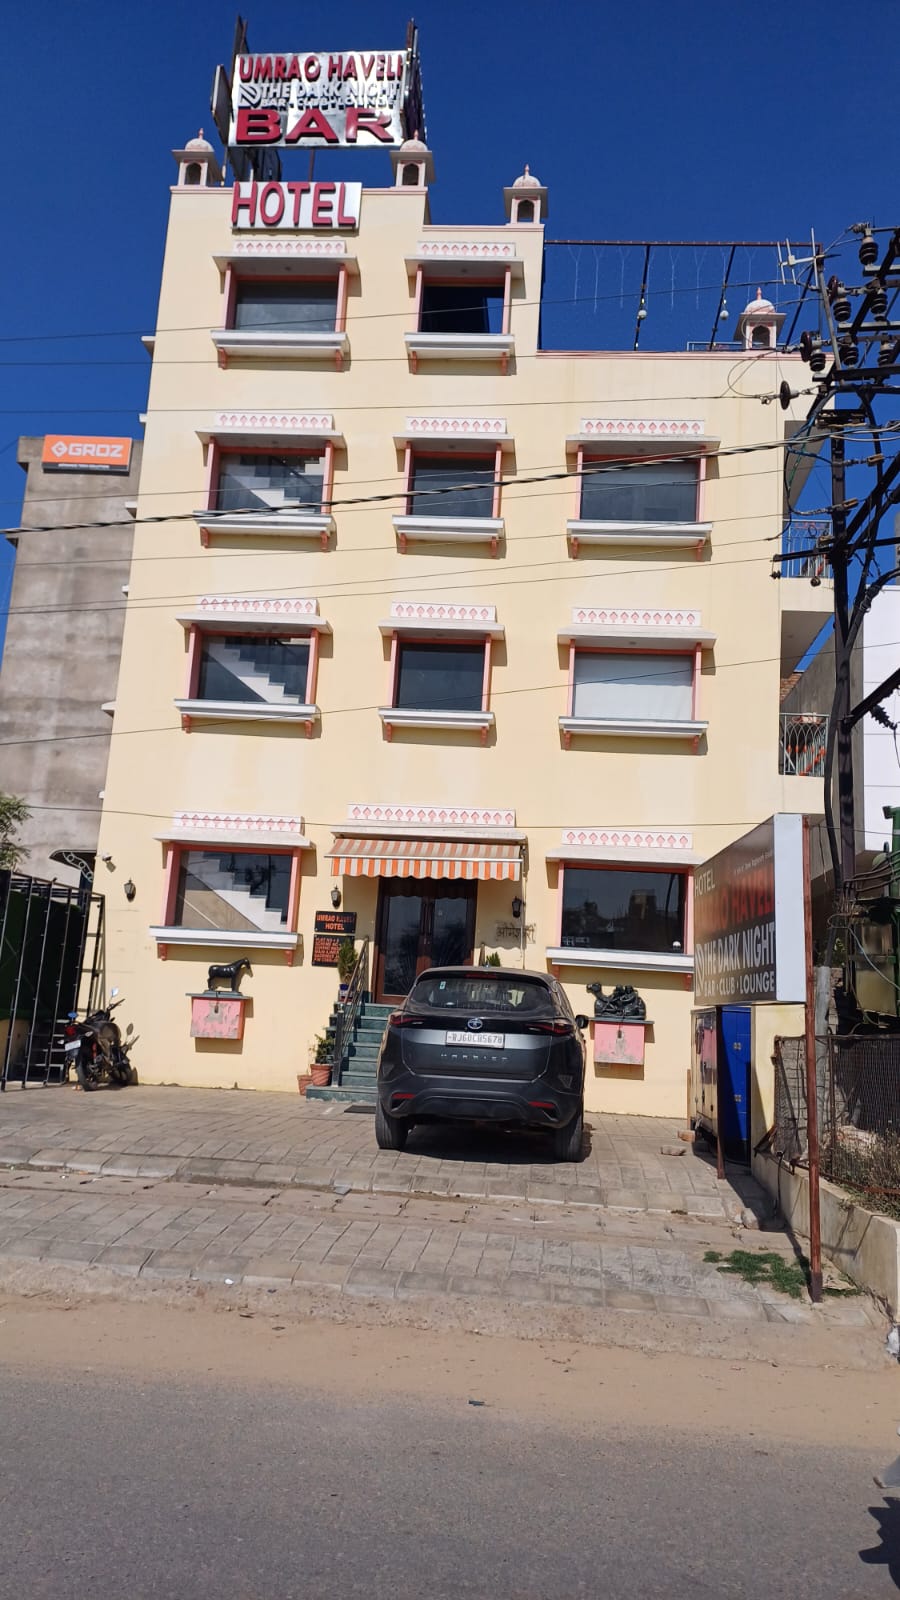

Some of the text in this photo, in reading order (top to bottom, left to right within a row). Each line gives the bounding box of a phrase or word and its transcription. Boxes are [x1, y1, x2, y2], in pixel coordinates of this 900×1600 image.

[239, 54, 402, 82] UMRAO HAVELI
[261, 82, 291, 99] THE
[297, 82, 341, 98] DARK
[236, 107, 394, 144] BAR
[231, 181, 356, 225] HOTEL
[67, 443, 123, 458] GROZ
[695, 869, 715, 897] HOTEL
[704, 940, 717, 976] THE
[718, 933, 740, 972] DARK
[742, 922, 775, 968] NIGHT
[704, 972, 775, 998] BAR CLUB LOUNGE
